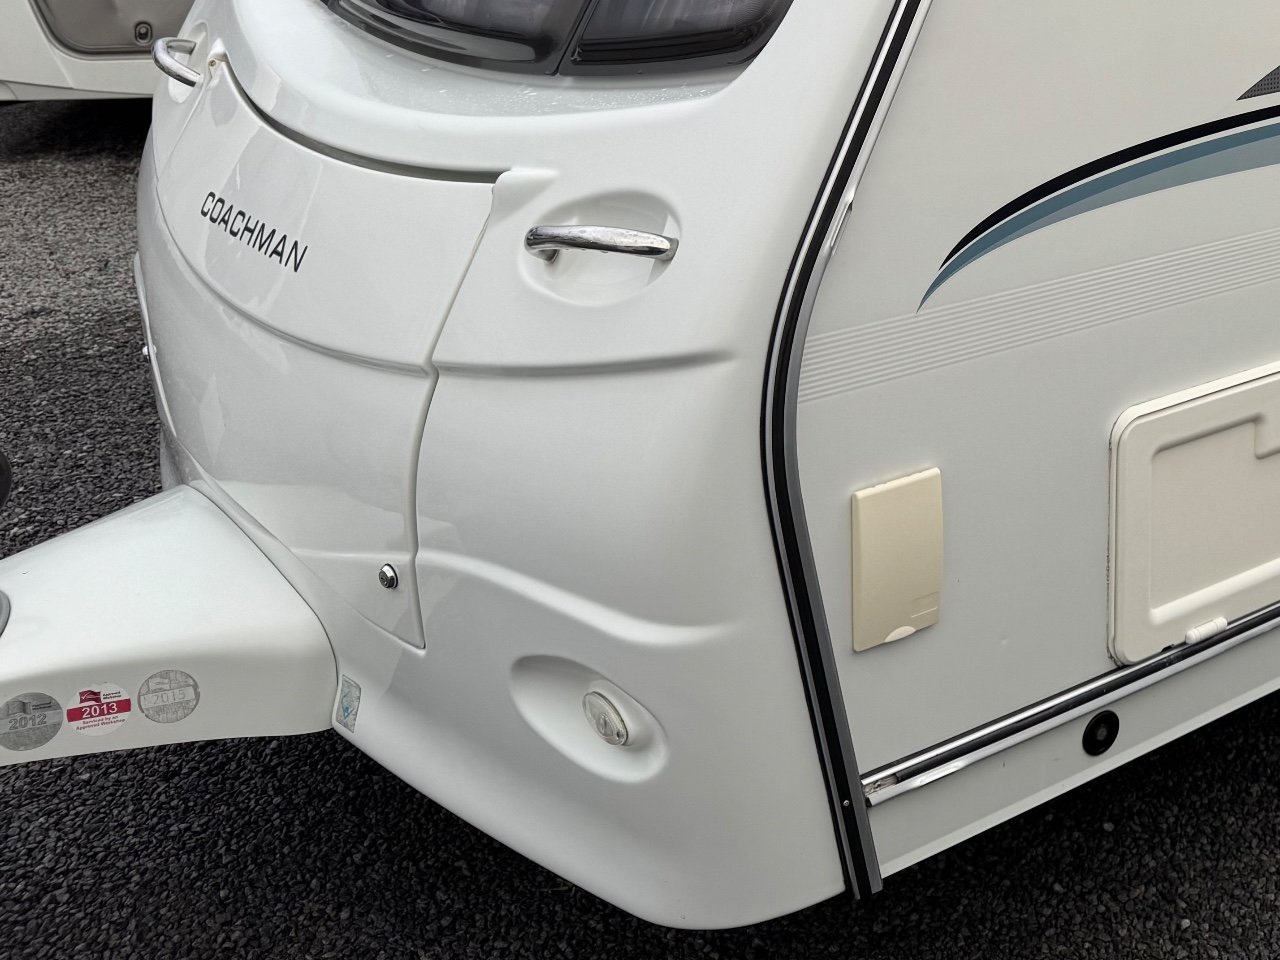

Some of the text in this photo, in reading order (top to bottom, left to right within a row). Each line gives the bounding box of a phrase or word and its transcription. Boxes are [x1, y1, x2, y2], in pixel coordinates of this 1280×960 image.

[201, 191, 308, 273] COACHMAN
[82, 702, 118, 719] 2013
[8, 713, 47, 731] 2012
